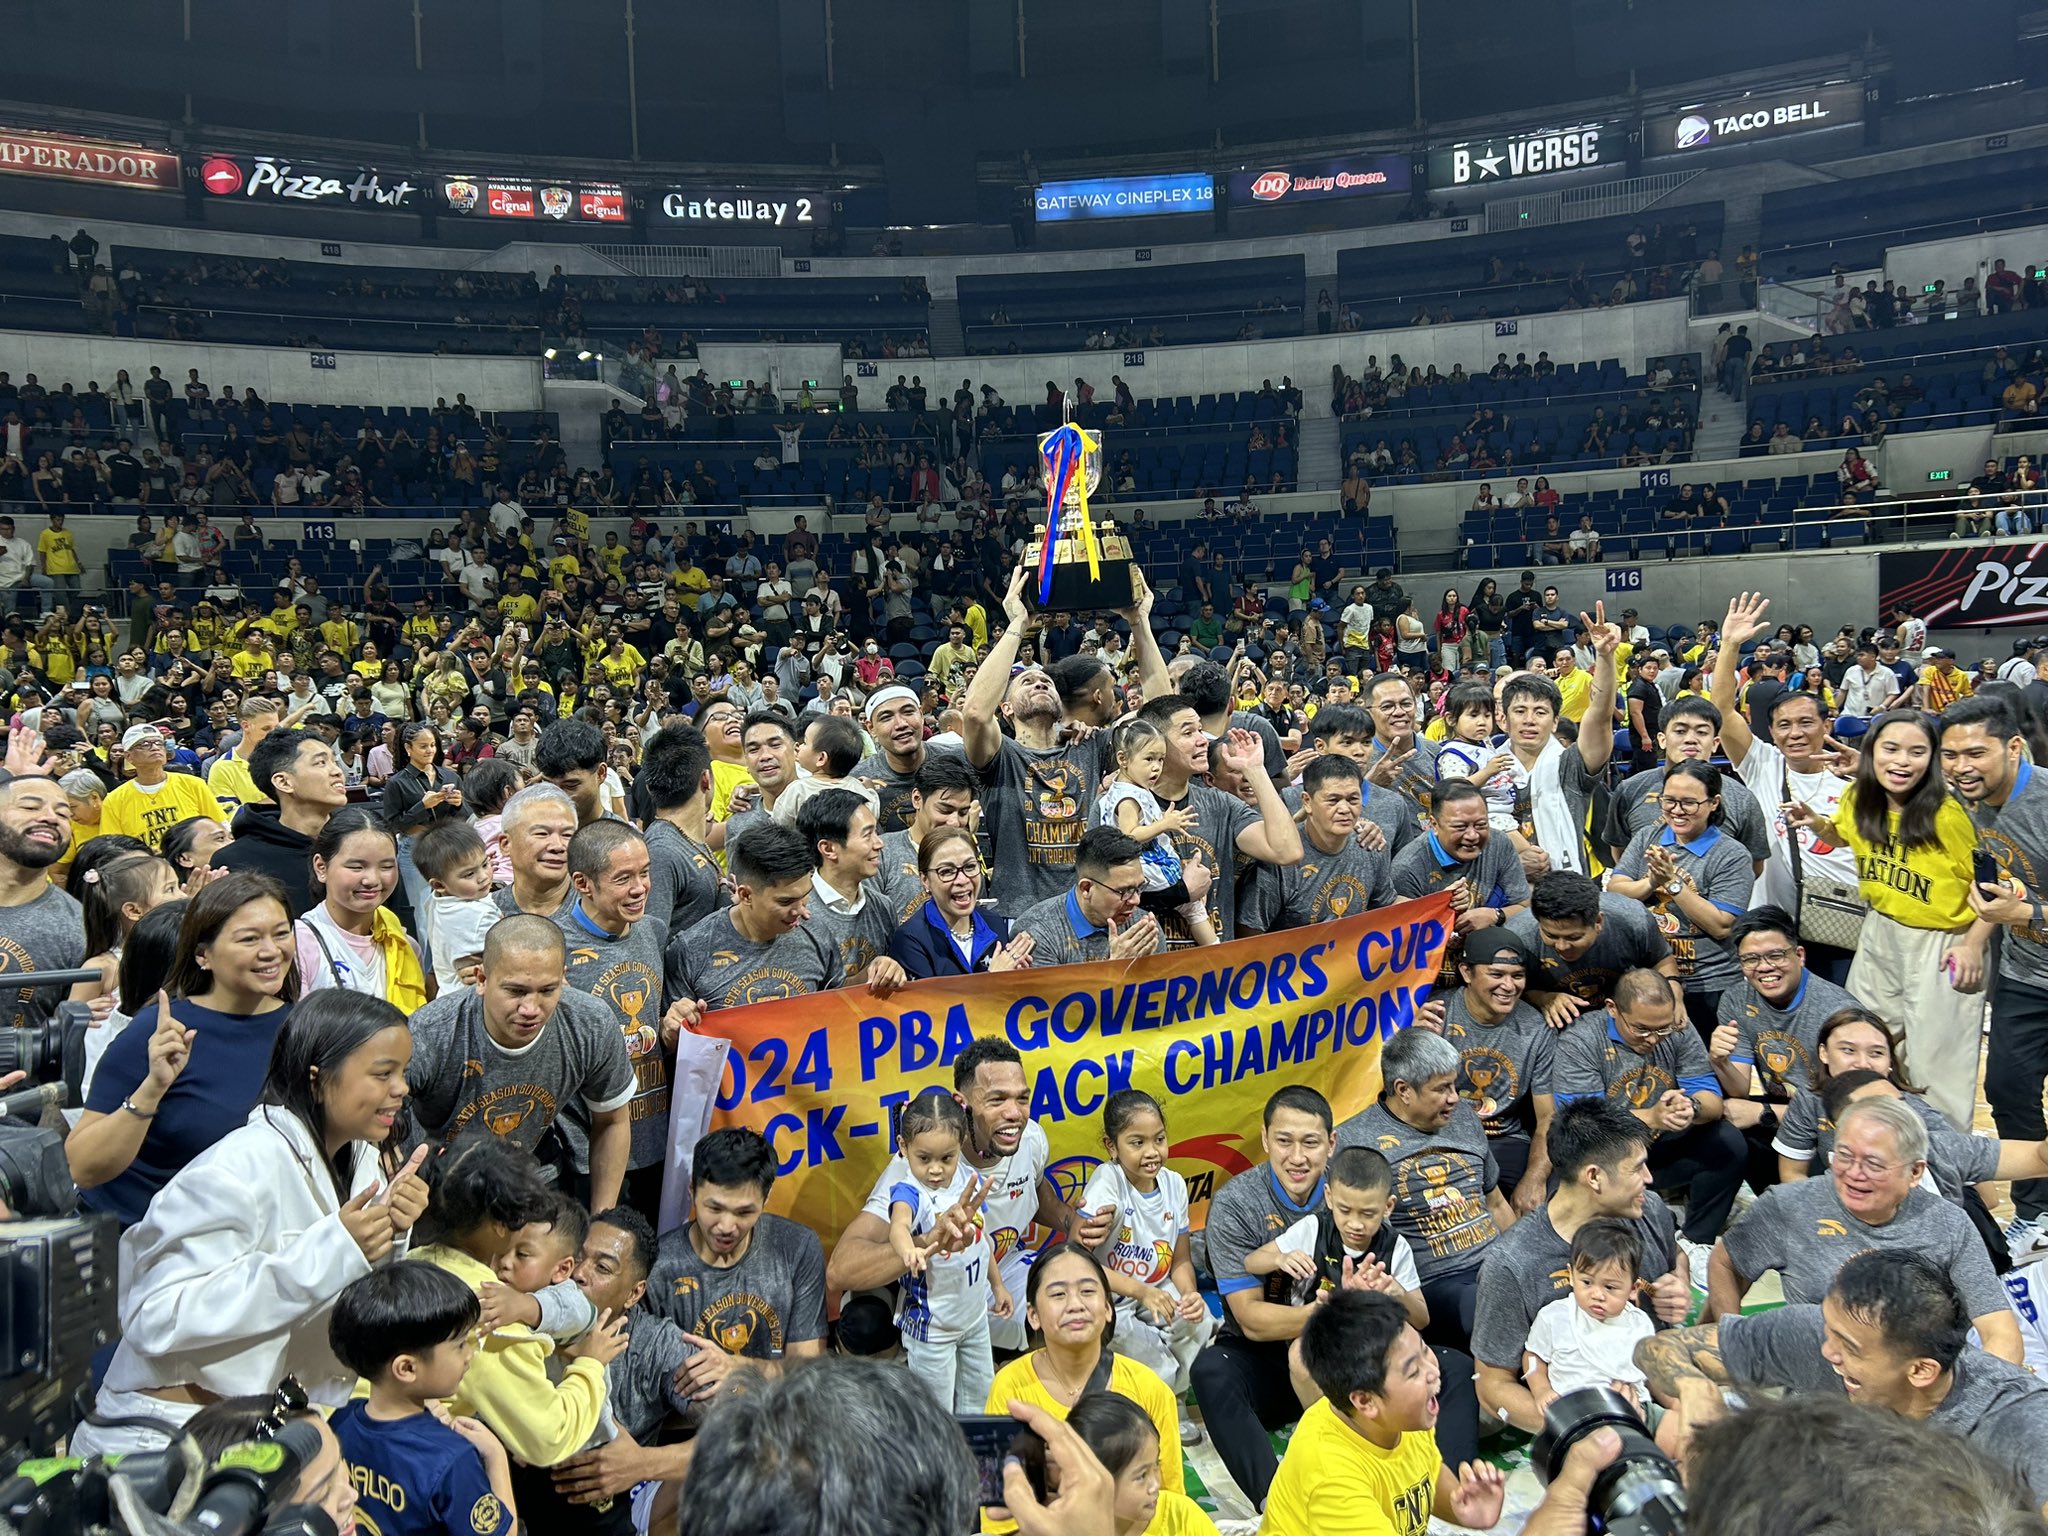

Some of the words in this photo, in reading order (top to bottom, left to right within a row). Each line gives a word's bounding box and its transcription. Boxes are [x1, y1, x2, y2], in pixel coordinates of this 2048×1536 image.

[1866, 90, 1878, 101] 18
[1714, 110, 1770, 135] TACO
[1773, 101, 1826, 125] BELL
[1628, 132, 1639, 143] 17
[1453, 150, 1470, 183] B
[1508, 131, 1598, 175] VERSE
[185, 166, 198, 178] 10
[1413, 164, 1424, 174] 16
[246, 162, 344, 199] Pizza
[346, 173, 417, 205] Hut
[487, 183, 521, 191] AVAILABLE
[1216, 185, 1226, 195] 15
[1258, 178, 1284, 194] DQ
[1294, 176, 1334, 191] Dairy
[423, 188, 434, 199] 11
[579, 188, 610, 196] AVAILABLE
[1036, 193, 1112, 210] GATEWAY
[1116, 188, 1191, 205] CINEPLEX
[1196, 187, 1213, 199] 18
[491, 199, 531, 215] Cignal
[544, 202, 569, 215] RUSH
[634, 200, 645, 209] 12
[796, 198, 812, 221] 2
[832, 202, 843, 212] 13
[1023, 198, 1033, 207] 14
[583, 202, 621, 218] Cignal
[311, 355, 335, 366] 216
[1125, 354, 1143, 364] 218
[858, 364, 876, 374] 217
[1642, 473, 1669, 487] 116
[1930, 470, 1949, 480] EXIT
[305, 525, 334, 539] 113
[1608, 572, 1640, 587] 116
[143, 807, 178, 828] TNT
[600, 964, 631, 986] SEASON
[738, 968, 770, 989] SEASON
[711, 1027, 832, 1111] 024
[859, 1003, 974, 1081] PBA
[1005, 940, 1335, 1052] GOVERNORS'
[1356, 918, 1446, 983] CUP
[477, 1085, 518, 1108] SEASON
[965, 1257, 980, 1288] 17
[701, 1293, 735, 1323] SEASON
